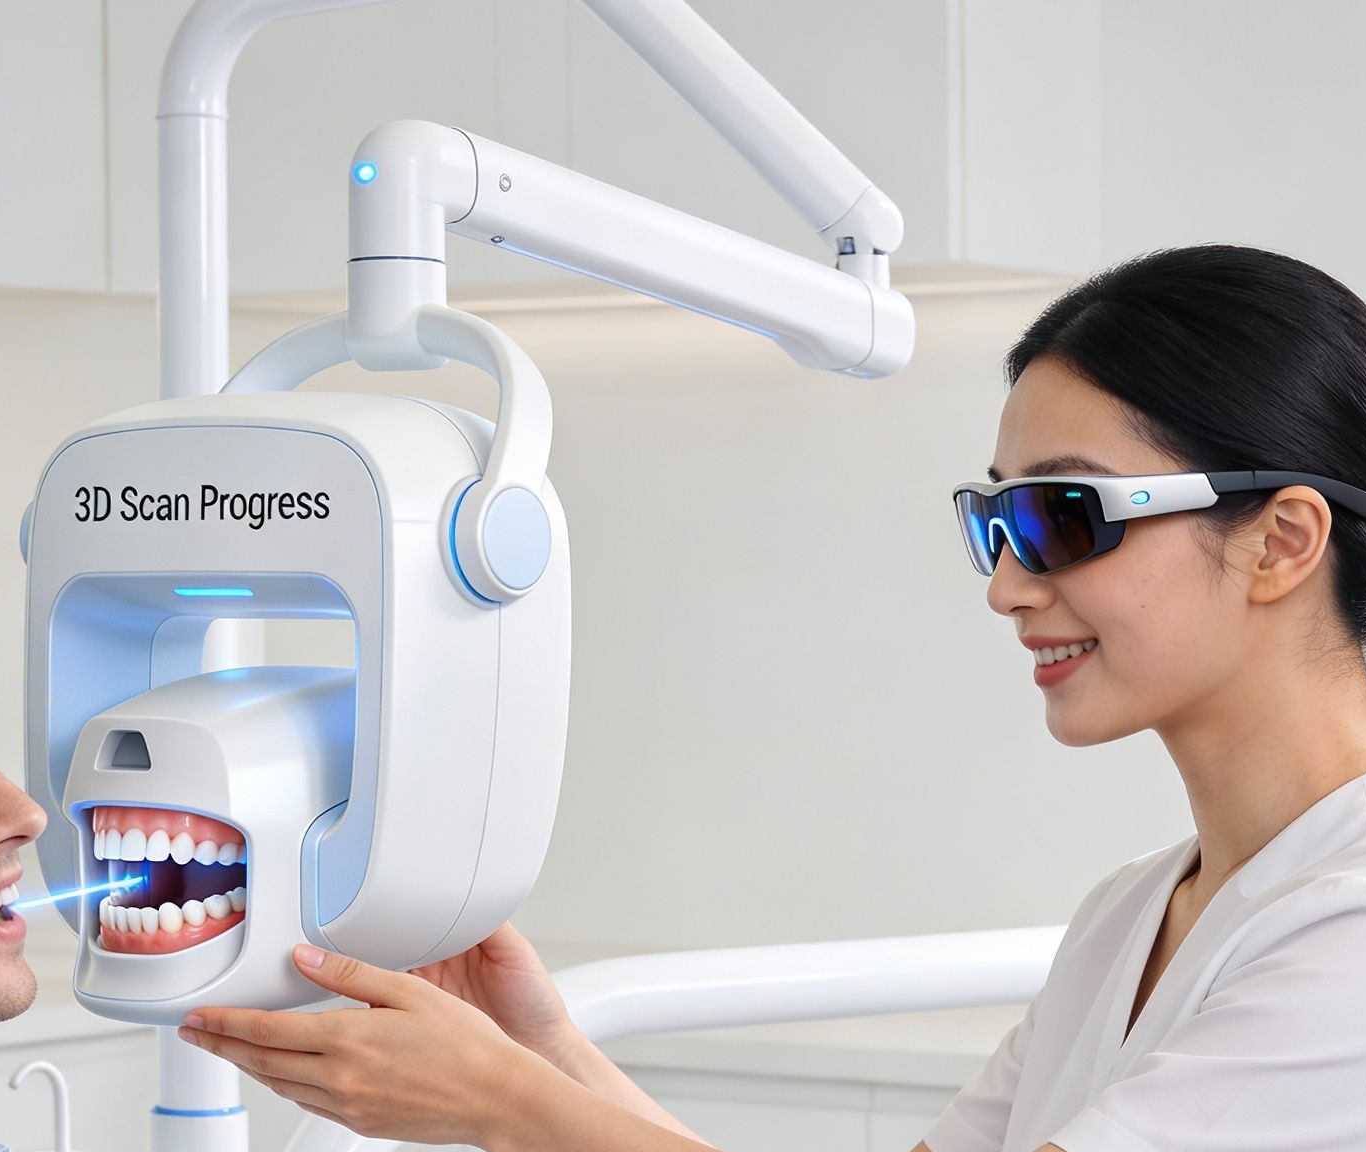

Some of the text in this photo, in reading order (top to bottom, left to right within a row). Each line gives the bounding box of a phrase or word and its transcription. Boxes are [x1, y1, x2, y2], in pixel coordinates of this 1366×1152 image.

[74, 484, 330, 531] 3D Scan Progress
